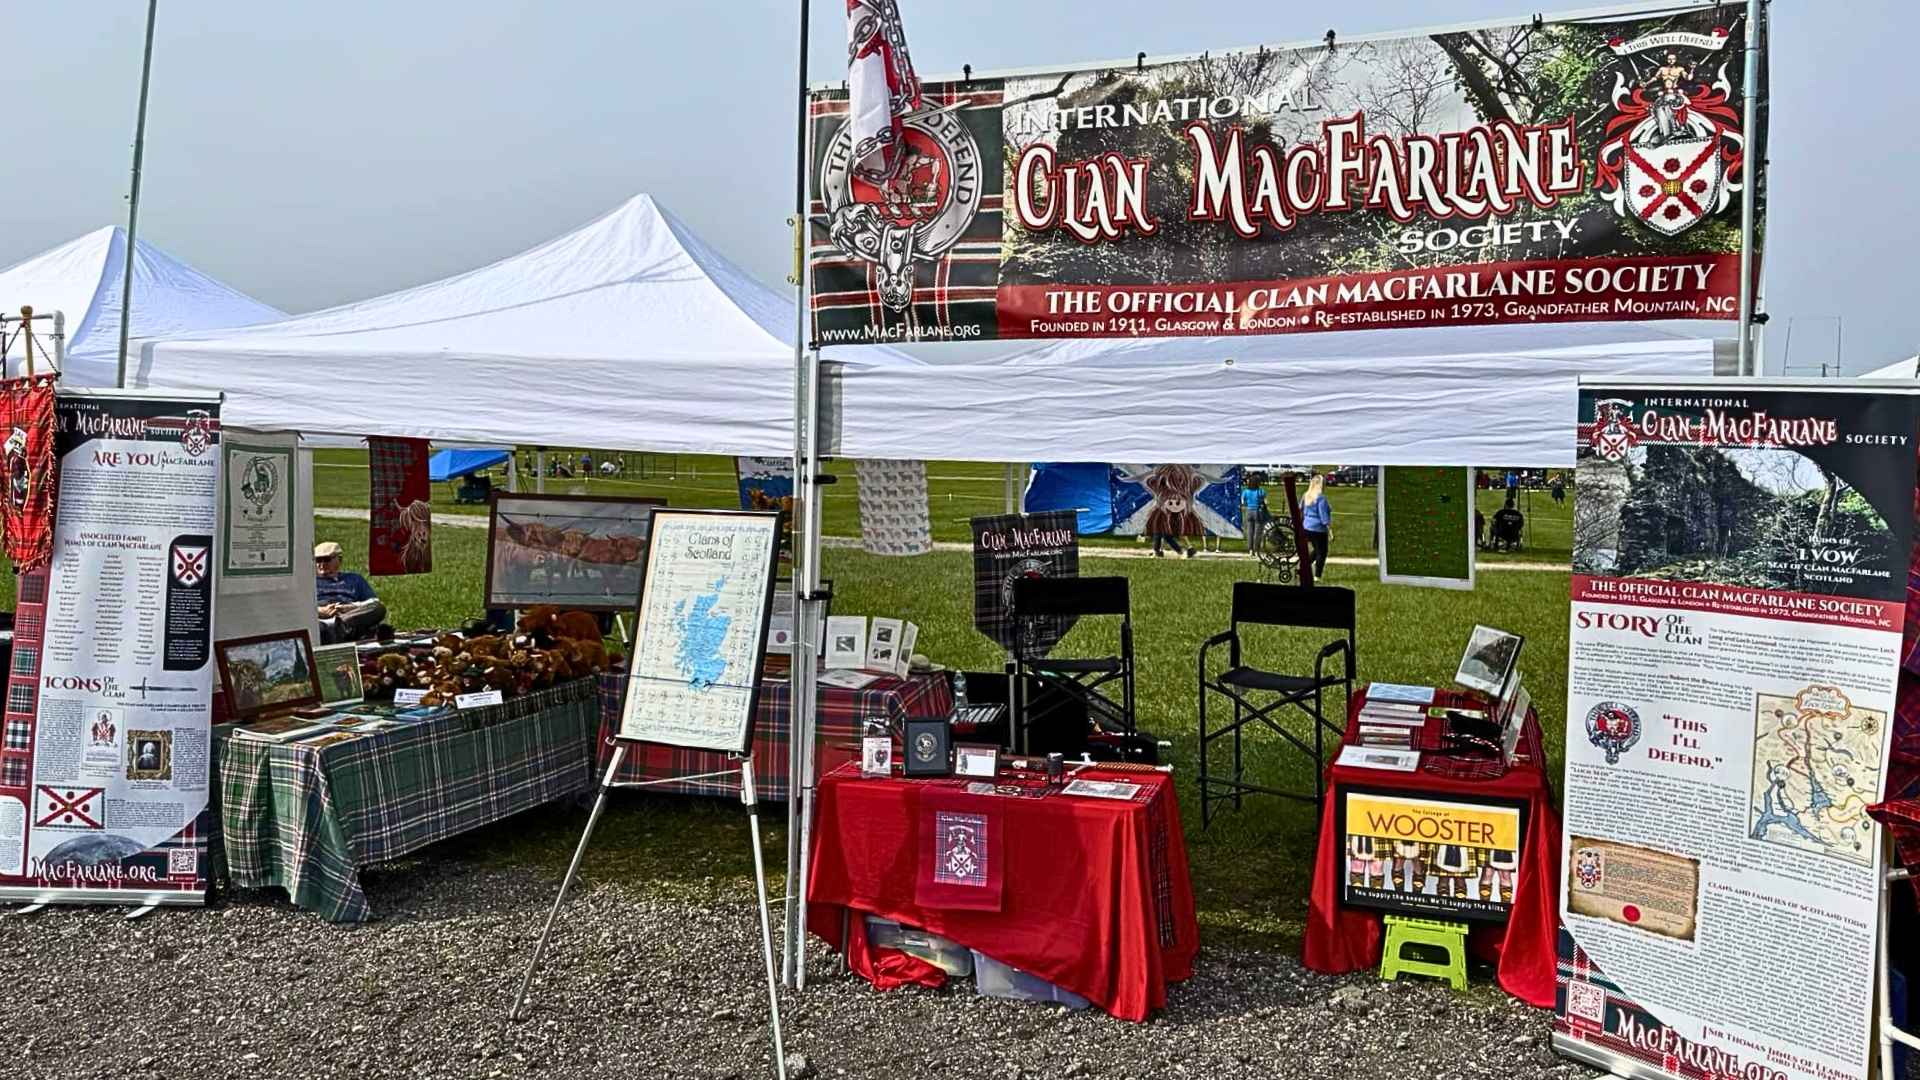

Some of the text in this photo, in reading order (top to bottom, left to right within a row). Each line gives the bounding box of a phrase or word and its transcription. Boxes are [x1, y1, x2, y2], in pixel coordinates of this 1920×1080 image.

[1015, 86, 1321, 134] INTERNATIONAL
[923, 112, 973, 206] DEFEND
[1015, 142, 1155, 243] CLAN
[1400, 216, 1579, 253] SOCIETY
[1046, 290, 1102, 314] THE
[1108, 289, 1241, 314] OFFICIAL
[1247, 284, 1333, 310] CLAN
[1564, 262, 1716, 295] SOCIETY
[1108, 318, 1150, 335] 1911,
[1222, 317, 1234, 330] &
[1450, 303, 1499, 320] 1973,
[1706, 296, 1736, 313] NC
[1644, 398, 1749, 409] INTERNATIONAL
[1642, 409, 1691, 442] CLAN
[1845, 434, 1908, 446] SOCIETY
[93, 450, 121, 467] ARE
[126, 452, 162, 466] YOU
[688, 532, 735, 549] Clans of
[982, 531, 1008, 550] CLAN
[684, 546, 732, 561] Scotland
[1803, 564, 1830, 573] CLAN
[1803, 572, 1854, 584] SCOTLAND
[1590, 580, 1617, 592] THE
[1619, 582, 1680, 598] OFFICIAL
[1682, 586, 1719, 600] CLAN
[1818, 599, 1884, 618] SOCIETY
[1576, 611, 1664, 638] STORY
[1666, 614, 1684, 625] OF
[1878, 618, 1892, 628] NC
[1666, 624, 1692, 634] THE
[1665, 634, 1702, 645] CLAN
[43, 676, 102, 693] ICONS
[104, 676, 115, 684] OF
[104, 684, 119, 692] THE
[102, 690, 126, 699] CLAN
[1367, 810, 1496, 846] WOOSTER
[1368, 890, 1390, 900] supply
[1449, 900, 1472, 909] supply
[1474, 902, 1486, 910] the
